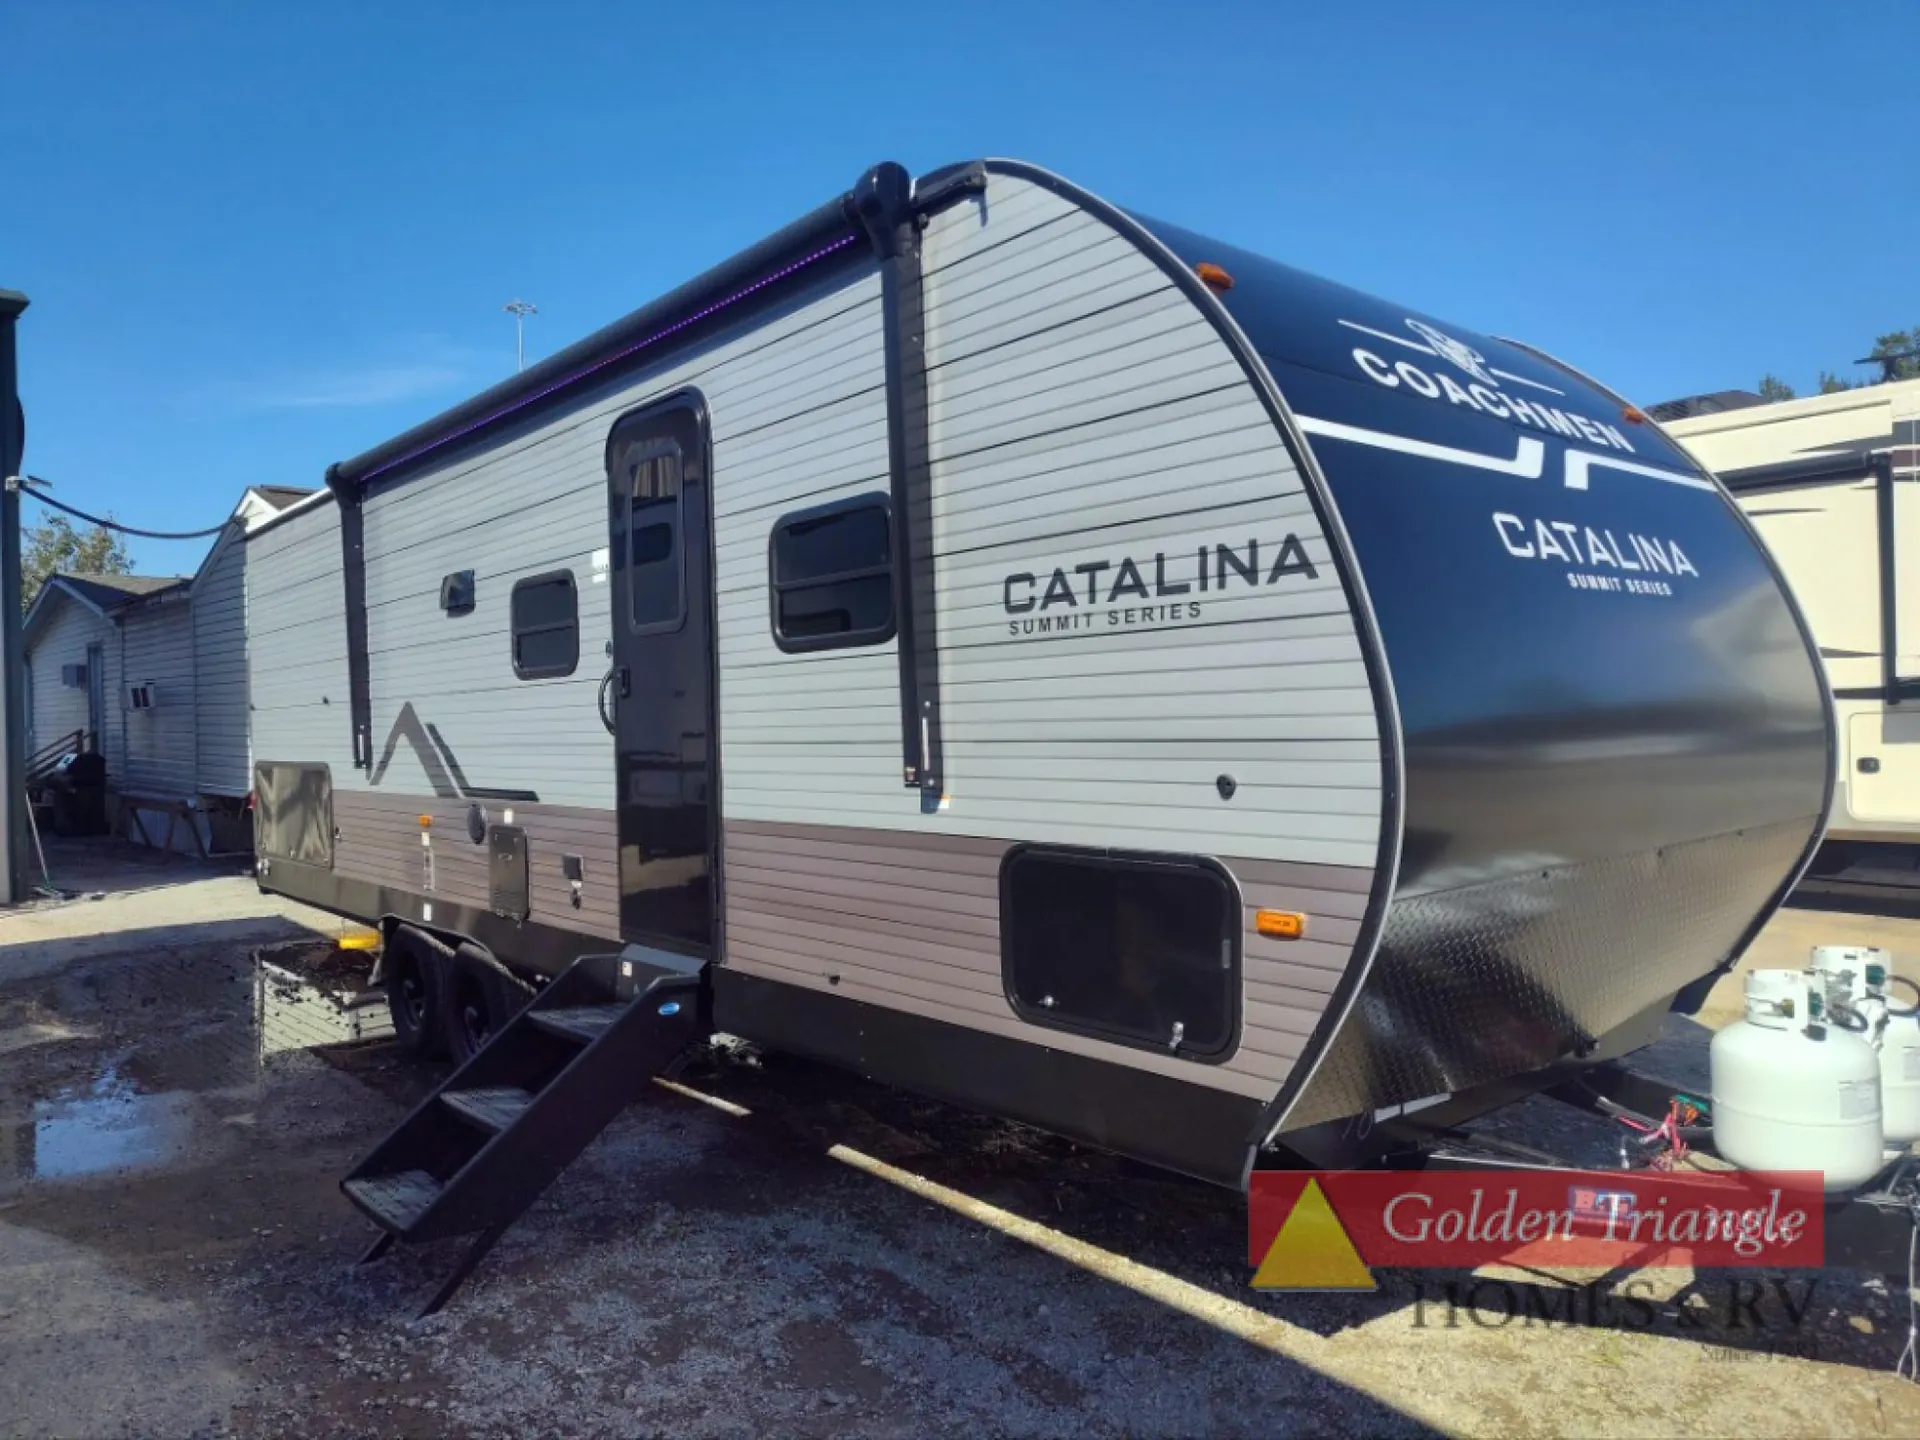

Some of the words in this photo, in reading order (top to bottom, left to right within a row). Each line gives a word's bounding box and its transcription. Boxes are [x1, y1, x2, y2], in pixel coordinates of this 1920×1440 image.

[1352, 348, 1636, 453] COACHMEN
[1003, 532, 1319, 614] CATALINA
[1492, 511, 1699, 578] CATALINA
[1567, 572, 1622, 592] SUMMIT
[1625, 578, 1674, 597] SERIES
[1009, 612, 1093, 636] SUMMIT
[1108, 601, 1202, 626] SERIES
